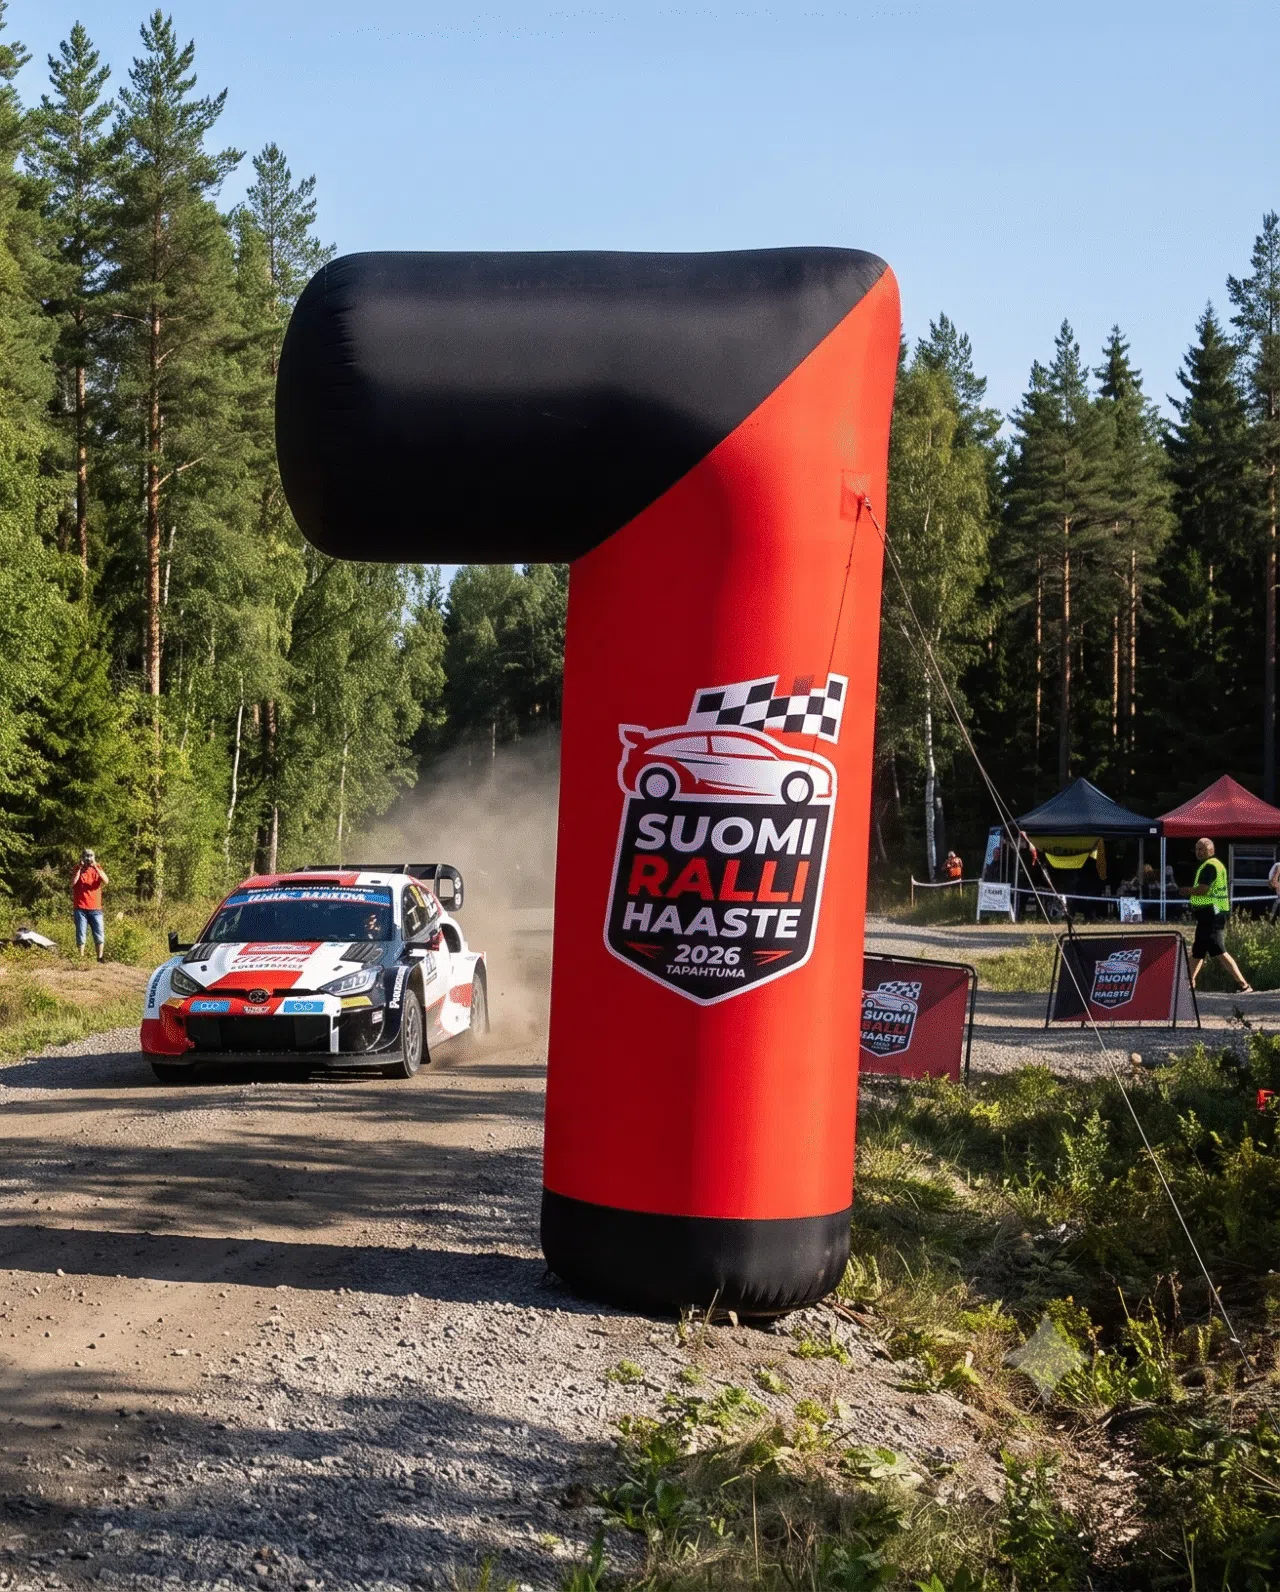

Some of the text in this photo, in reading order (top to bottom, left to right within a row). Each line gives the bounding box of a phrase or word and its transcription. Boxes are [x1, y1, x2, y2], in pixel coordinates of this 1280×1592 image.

[634, 813, 818, 855] SUOMI
[627, 855, 810, 903] RALLI
[622, 901, 802, 939] HAASTE
[674, 944, 741, 965] 2026
[666, 964, 746, 979] TAPAHTUMA
[1098, 974, 1135, 983] SUOMI
[863, 1010, 911, 1024] SUOMI
